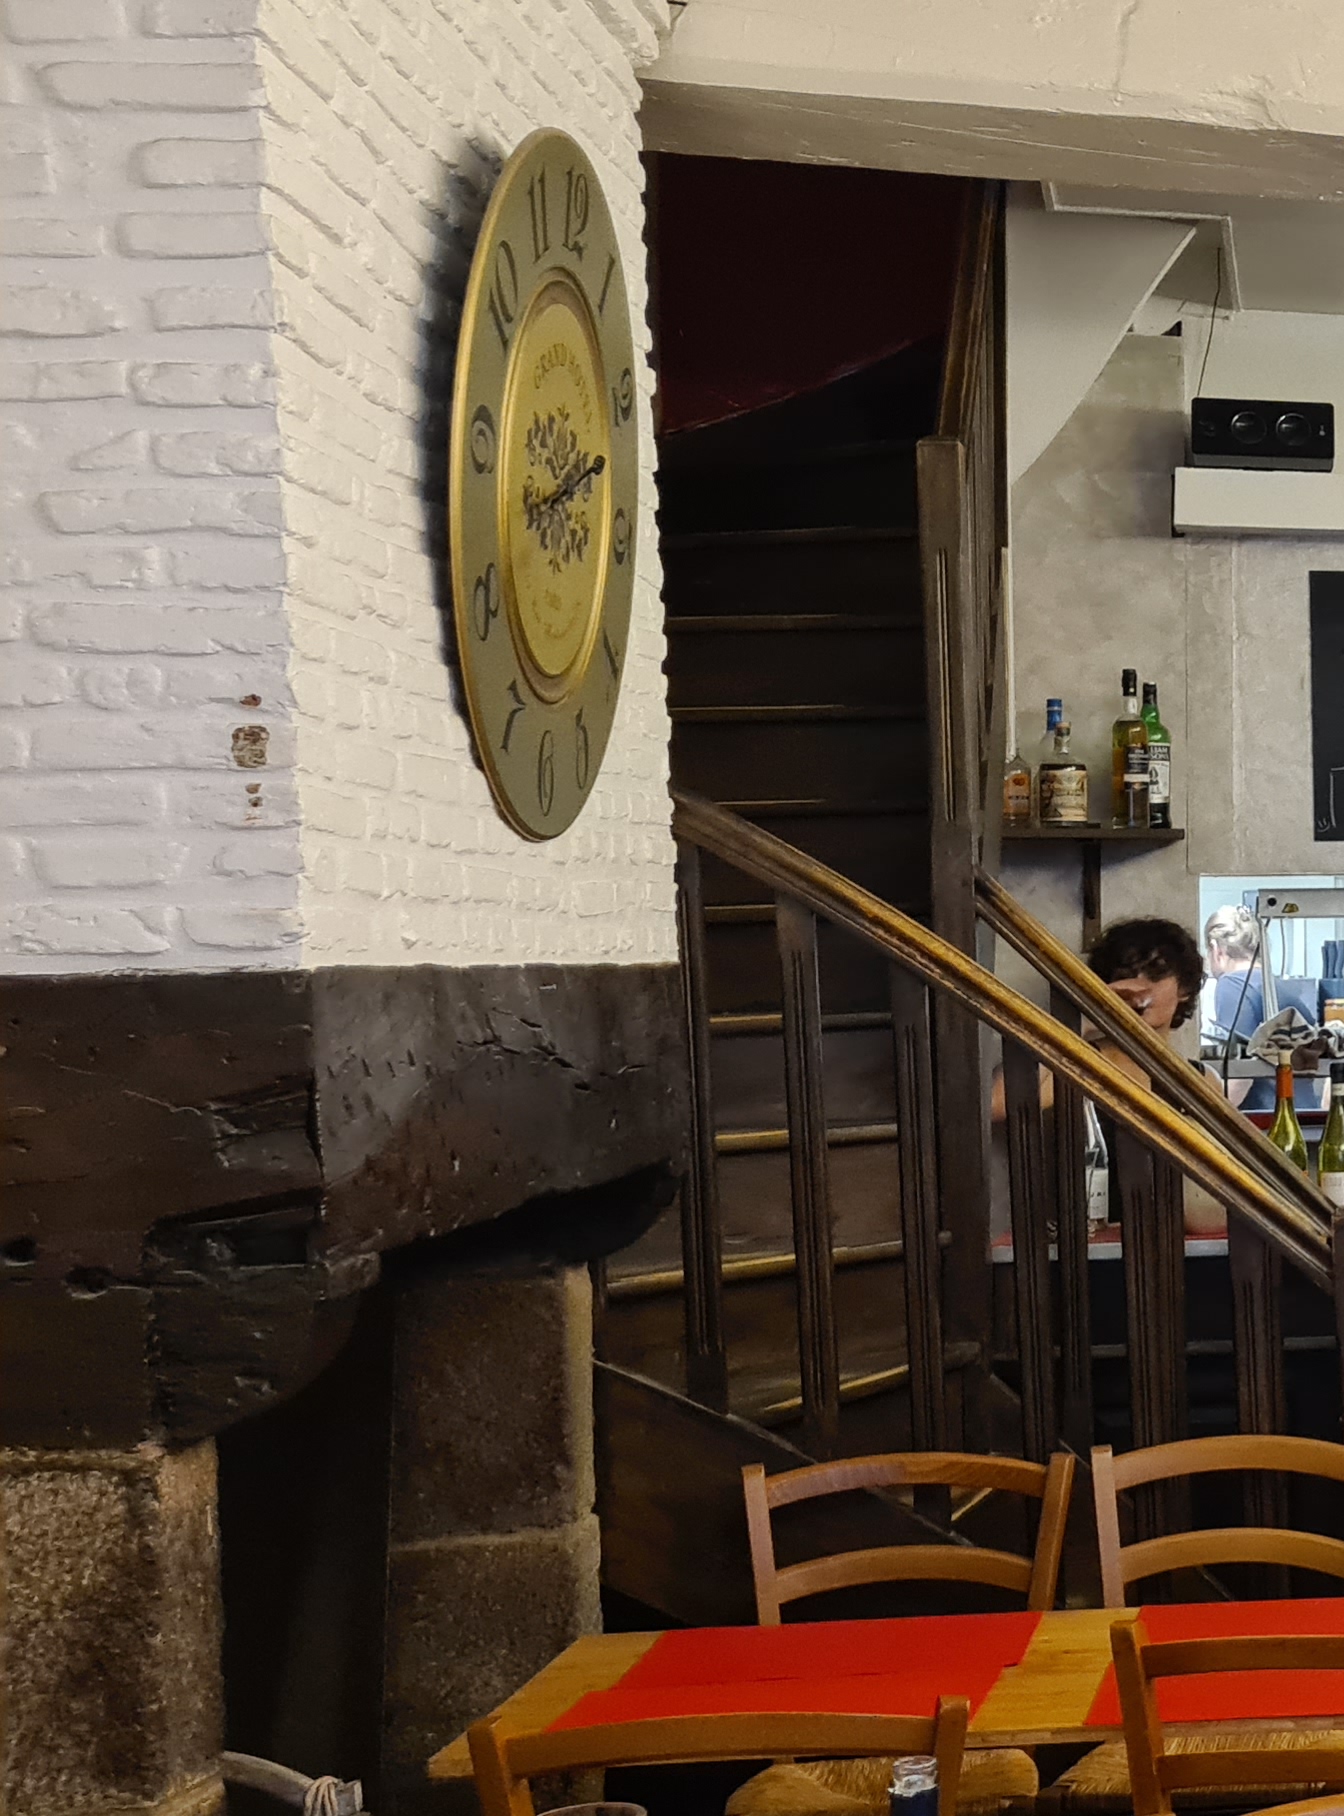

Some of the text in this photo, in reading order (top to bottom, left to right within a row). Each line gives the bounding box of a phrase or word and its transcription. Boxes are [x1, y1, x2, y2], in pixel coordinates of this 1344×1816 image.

[528, 162, 549, 264] 11
[488, 239, 518, 355] 10
[473, 562, 500, 641] 8
[538, 730, 554, 816] 6
